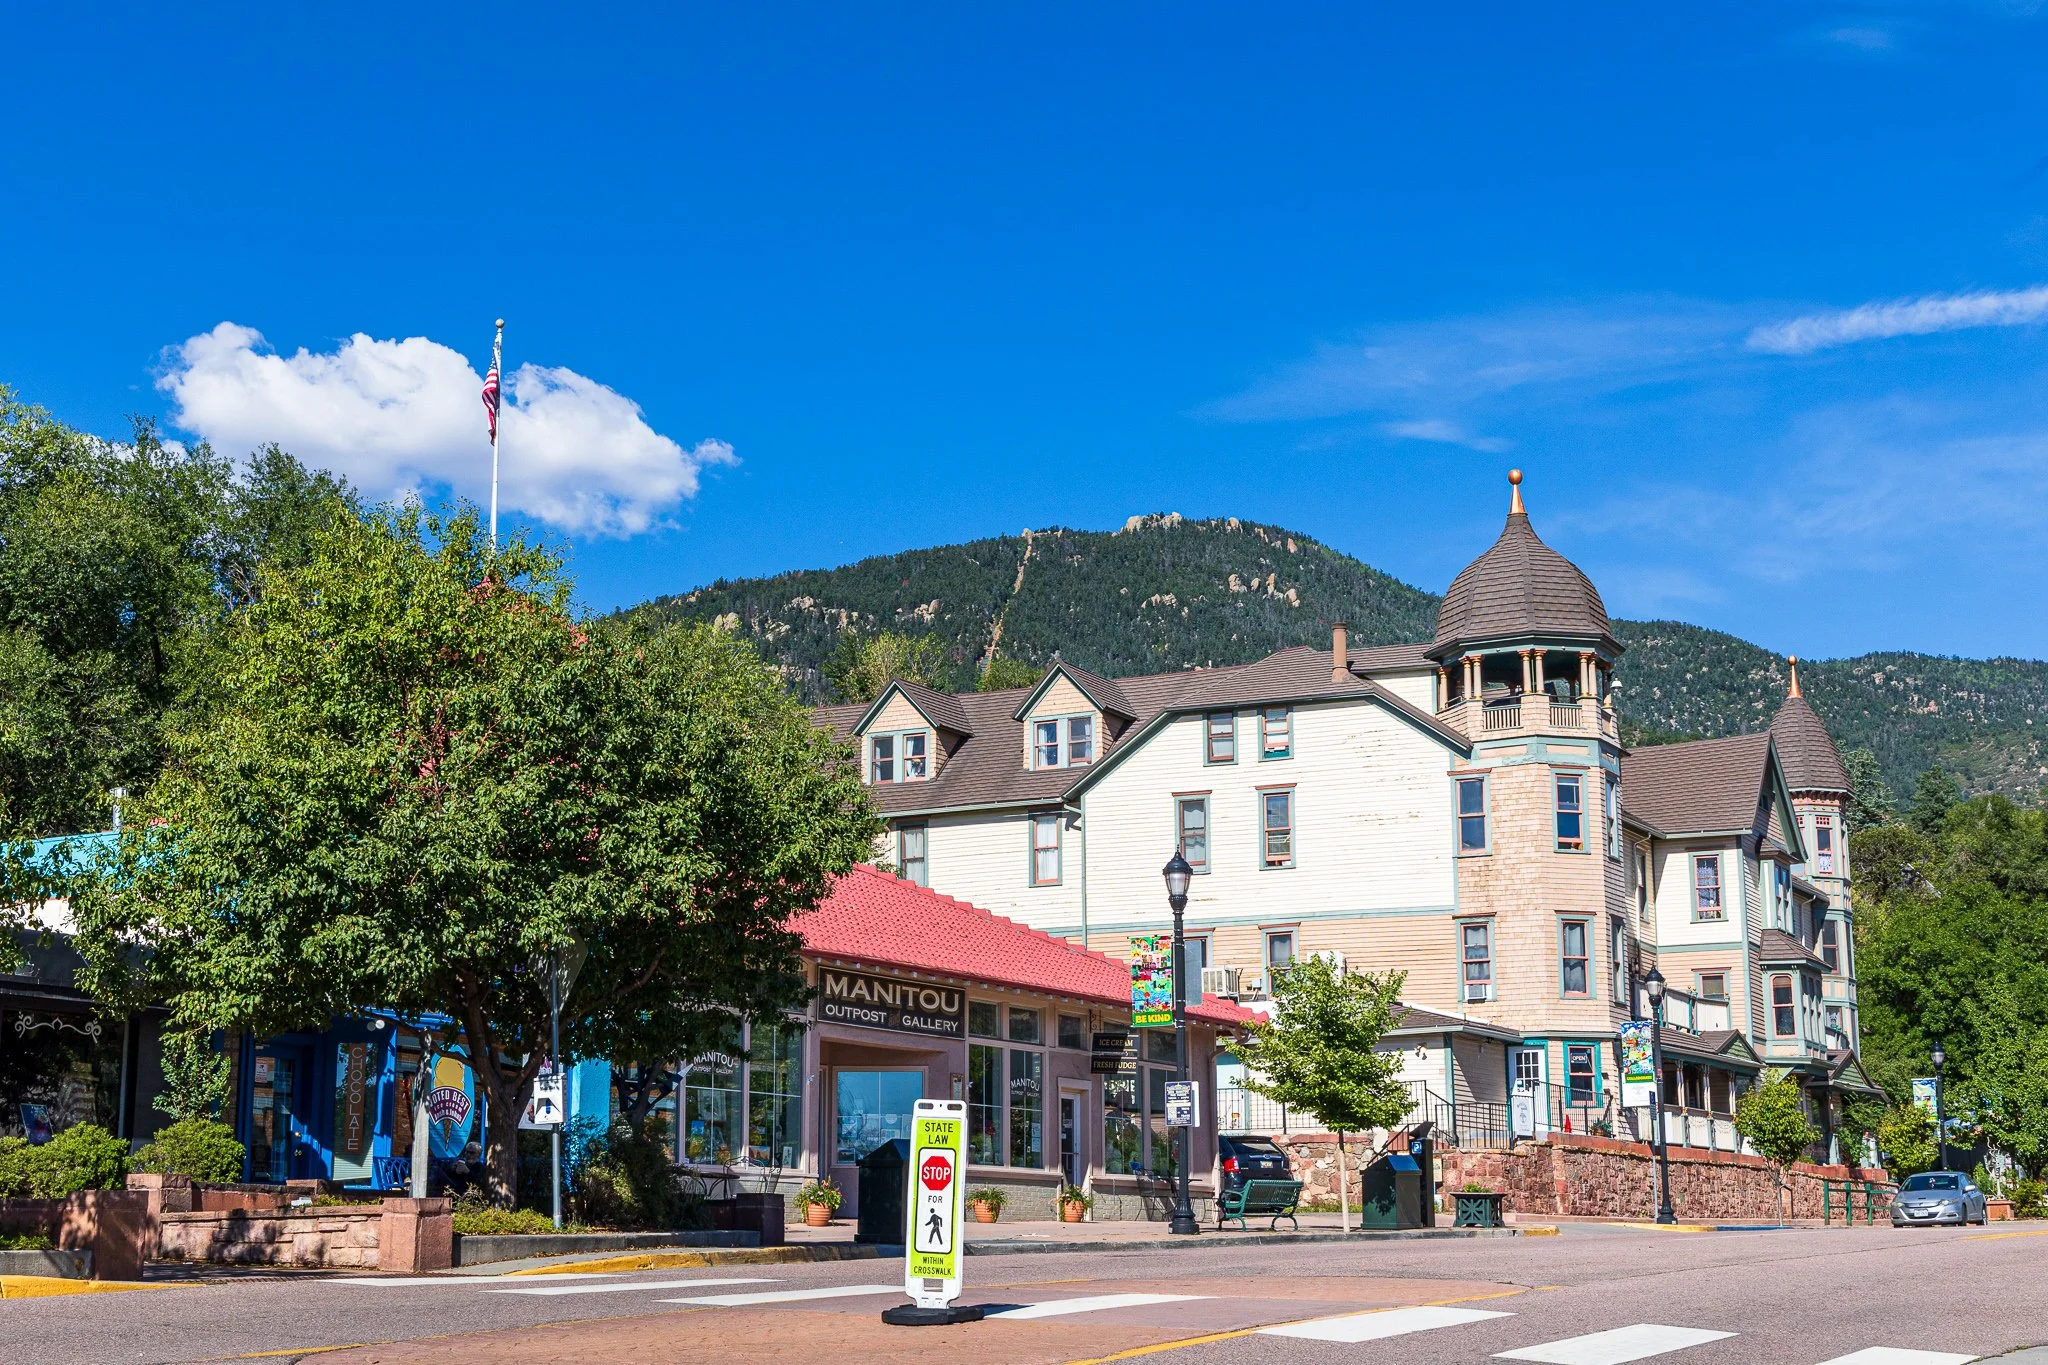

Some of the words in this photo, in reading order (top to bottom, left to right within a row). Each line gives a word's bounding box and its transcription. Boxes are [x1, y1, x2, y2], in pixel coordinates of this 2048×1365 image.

[825, 974, 959, 1013] MANITOU
[825, 1004, 887, 1023] OUTPOST
[902, 1015, 959, 1032] GALLERY
[1135, 1015, 1147, 1023] BE
[1148, 1013, 1171, 1023] KIND
[1111, 1039, 1134, 1047] CREAM
[693, 1051, 734, 1068] MANITOU
[1093, 1061, 1114, 1069] FRESH
[1115, 1061, 1137, 1069] FUDGE
[1010, 1077, 1040, 1092] MANITOU
[347, 1047, 363, 1150] CHOCOLATE
[452, 1090, 470, 1111] BEST
[924, 1122, 954, 1133] STATE
[928, 1135, 949, 1145] LAW
[923, 1166, 951, 1181] STOP
[928, 1195, 943, 1204] FOR
[922, 1256, 944, 1265] WITHIN
[913, 1266, 952, 1276] CROSSWALK
